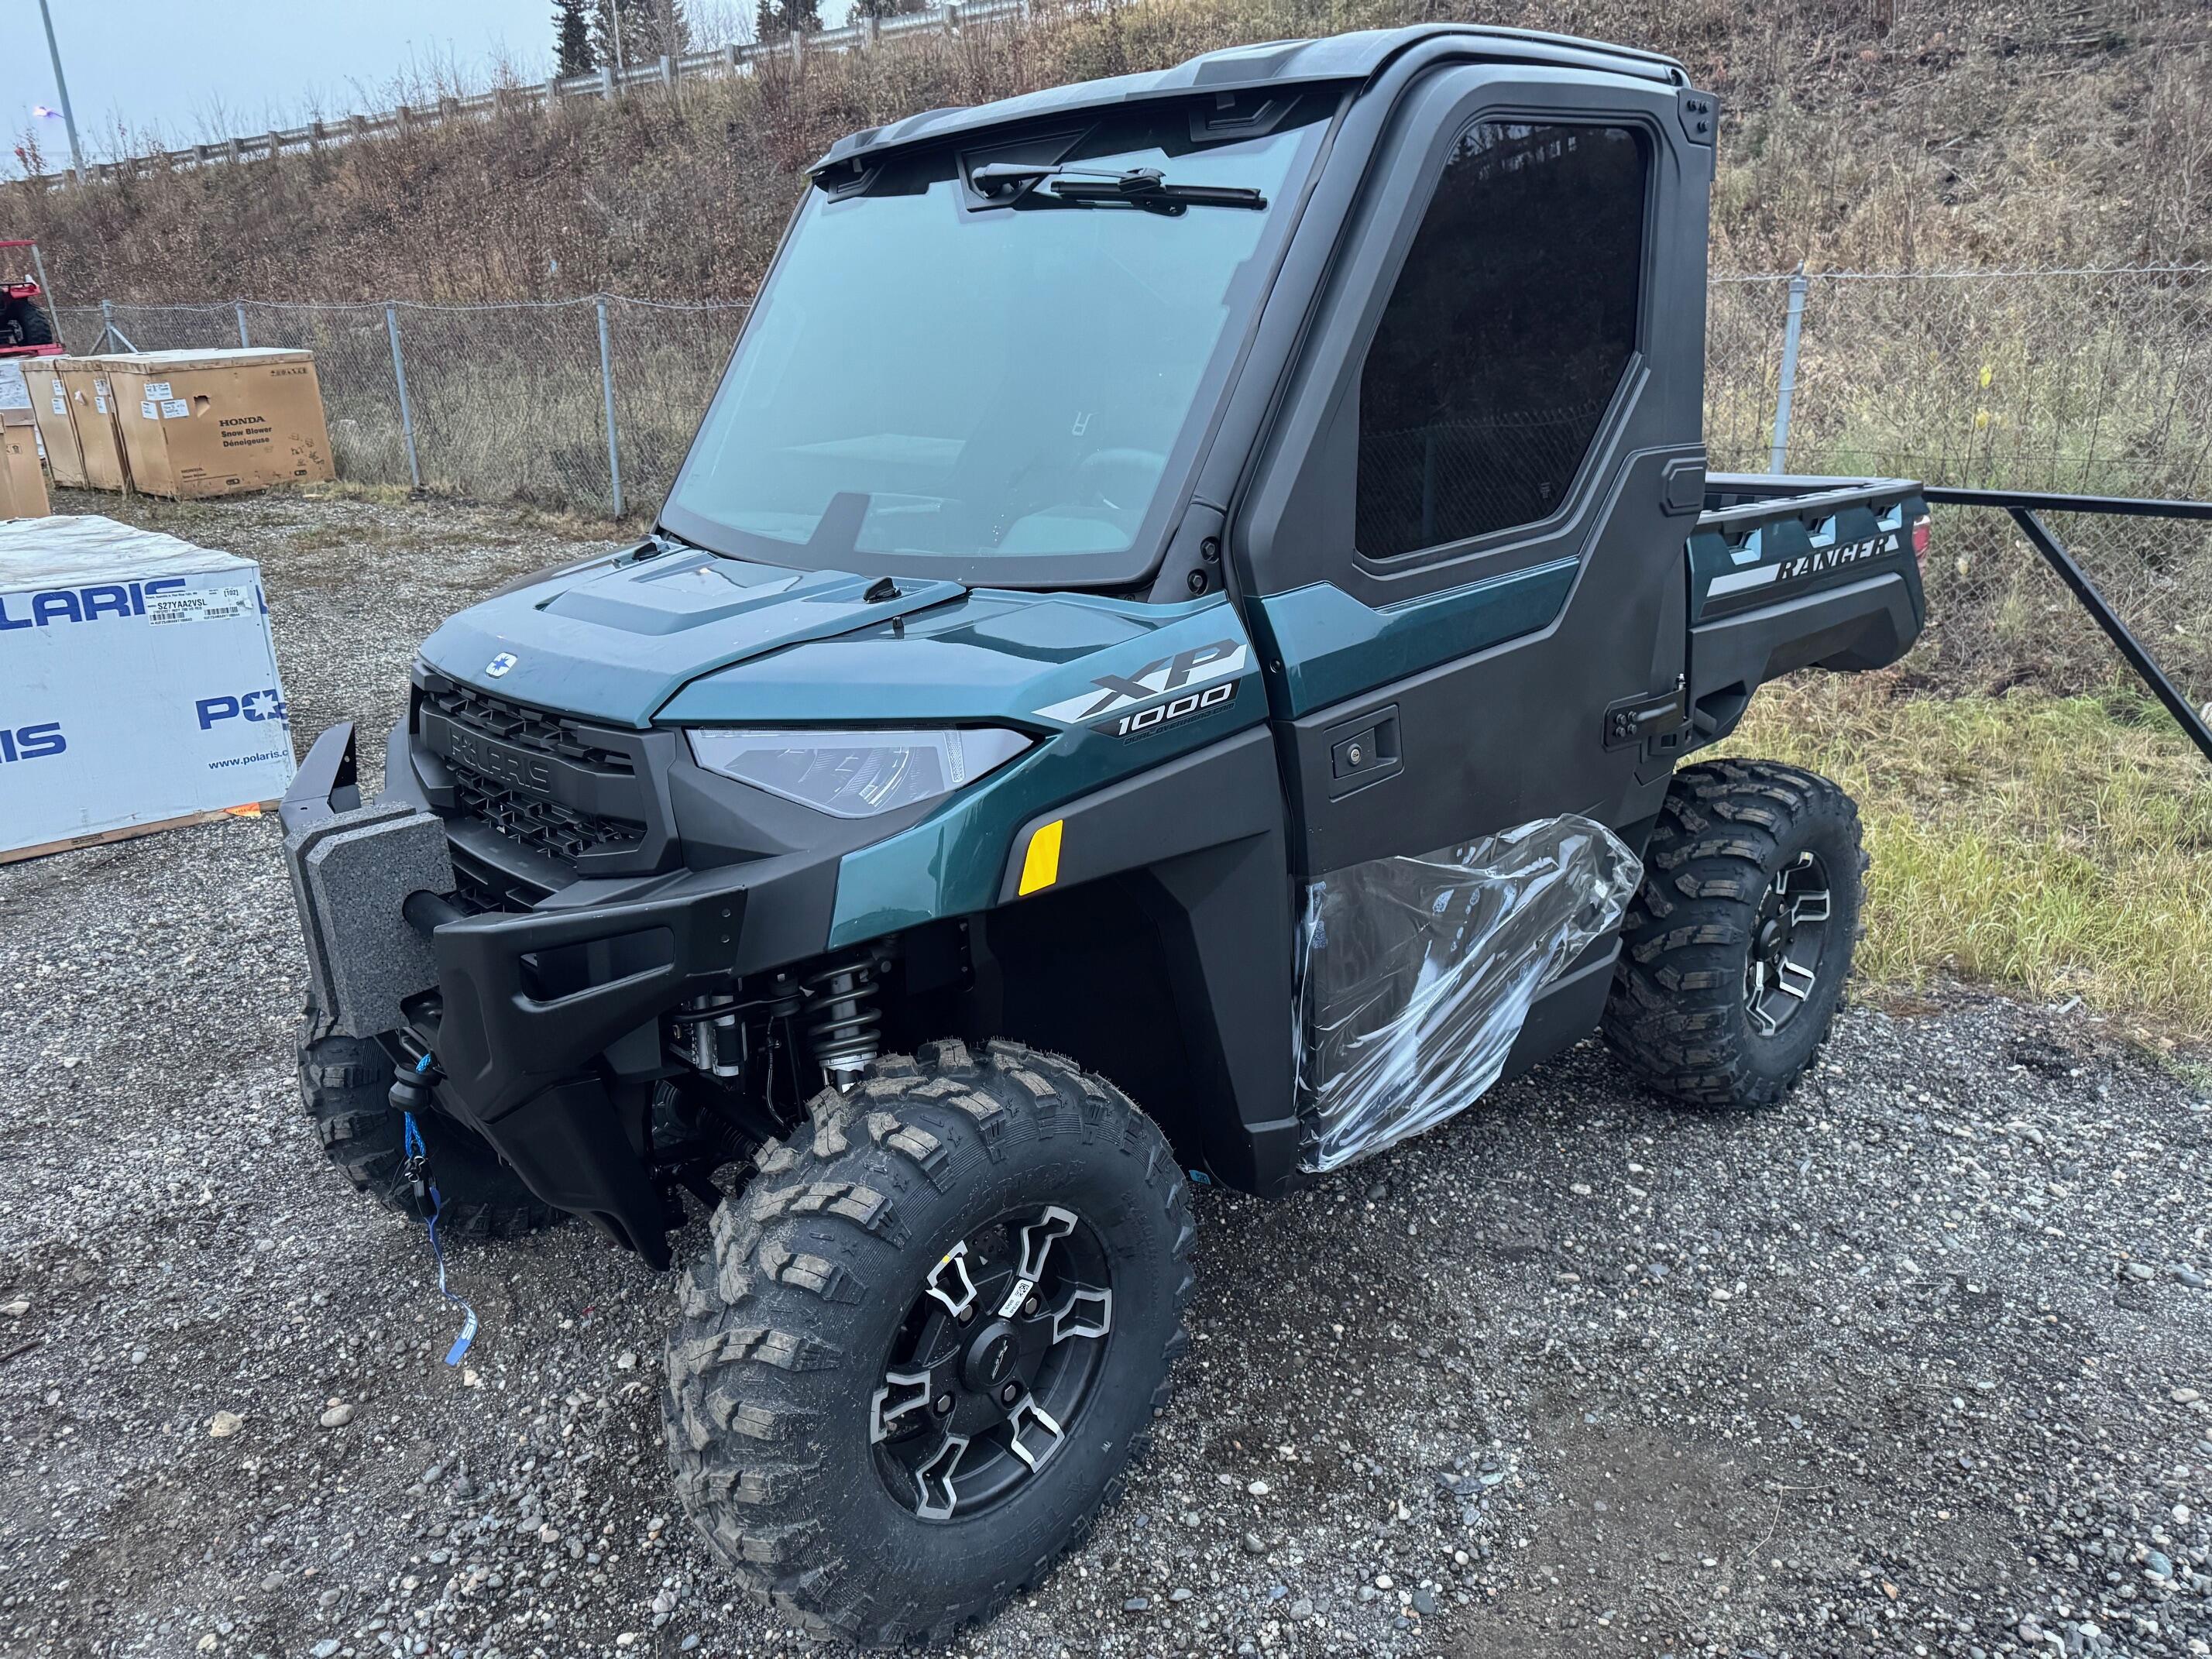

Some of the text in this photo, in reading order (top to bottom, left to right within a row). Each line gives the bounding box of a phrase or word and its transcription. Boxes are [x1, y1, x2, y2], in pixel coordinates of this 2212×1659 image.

[219, 416, 266, 427] HONDA
[246, 427, 272, 435] Blower
[1775, 535, 1890, 582] RANGER
[1076, 639, 1240, 720] XP
[1118, 683, 1231, 736] 1000
[449, 727, 551, 793] POLARIS
